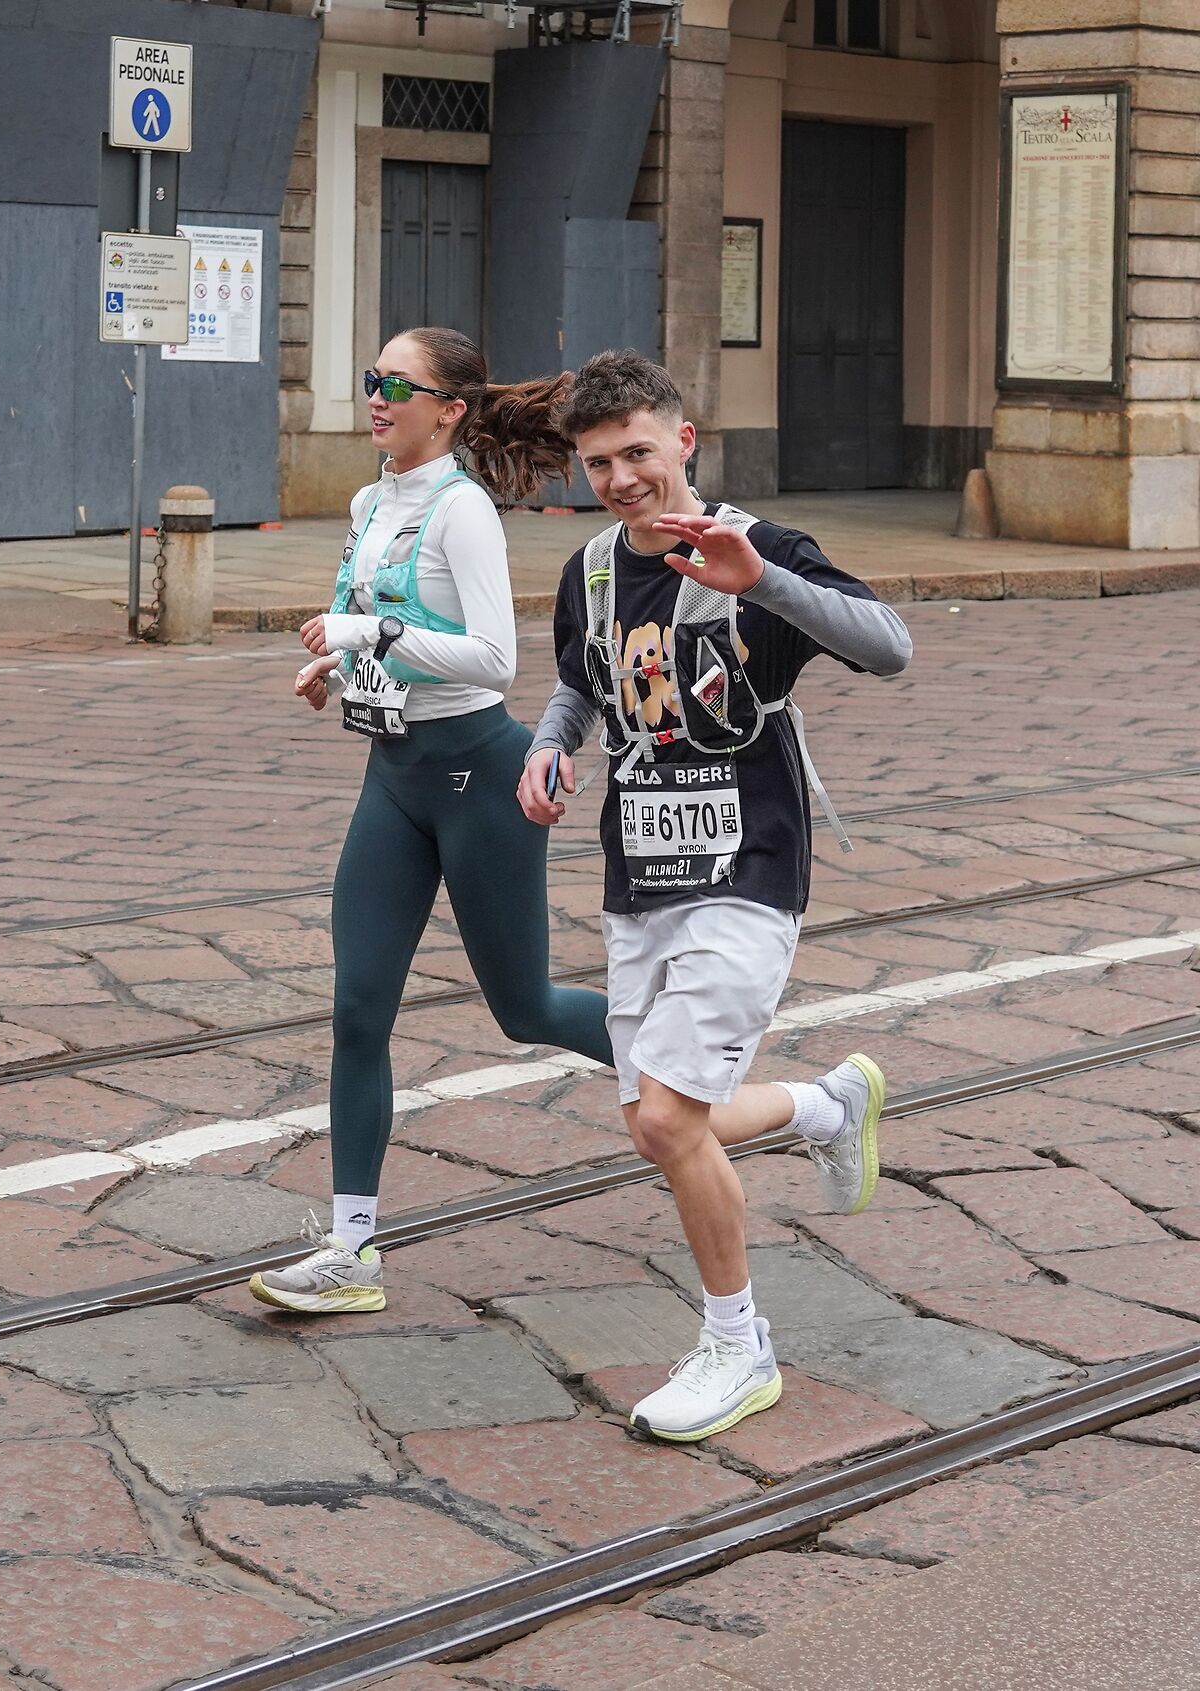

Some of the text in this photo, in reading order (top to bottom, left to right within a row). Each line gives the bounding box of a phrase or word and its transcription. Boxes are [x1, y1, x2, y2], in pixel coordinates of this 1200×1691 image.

[136, 47, 170, 65] AREA
[119, 64, 185, 85] PEDONALE
[1021, 130, 1058, 145] TEATRO
[1075, 128, 1113, 143] SCALA
[624, 769, 663, 785] FILA
[622, 799, 636, 821] 21
[624, 821, 637, 836] KM
[658, 802, 718, 842] 6170
[677, 844, 707, 854] BYRON
[638, 878, 699, 887] FollowYourPassion
